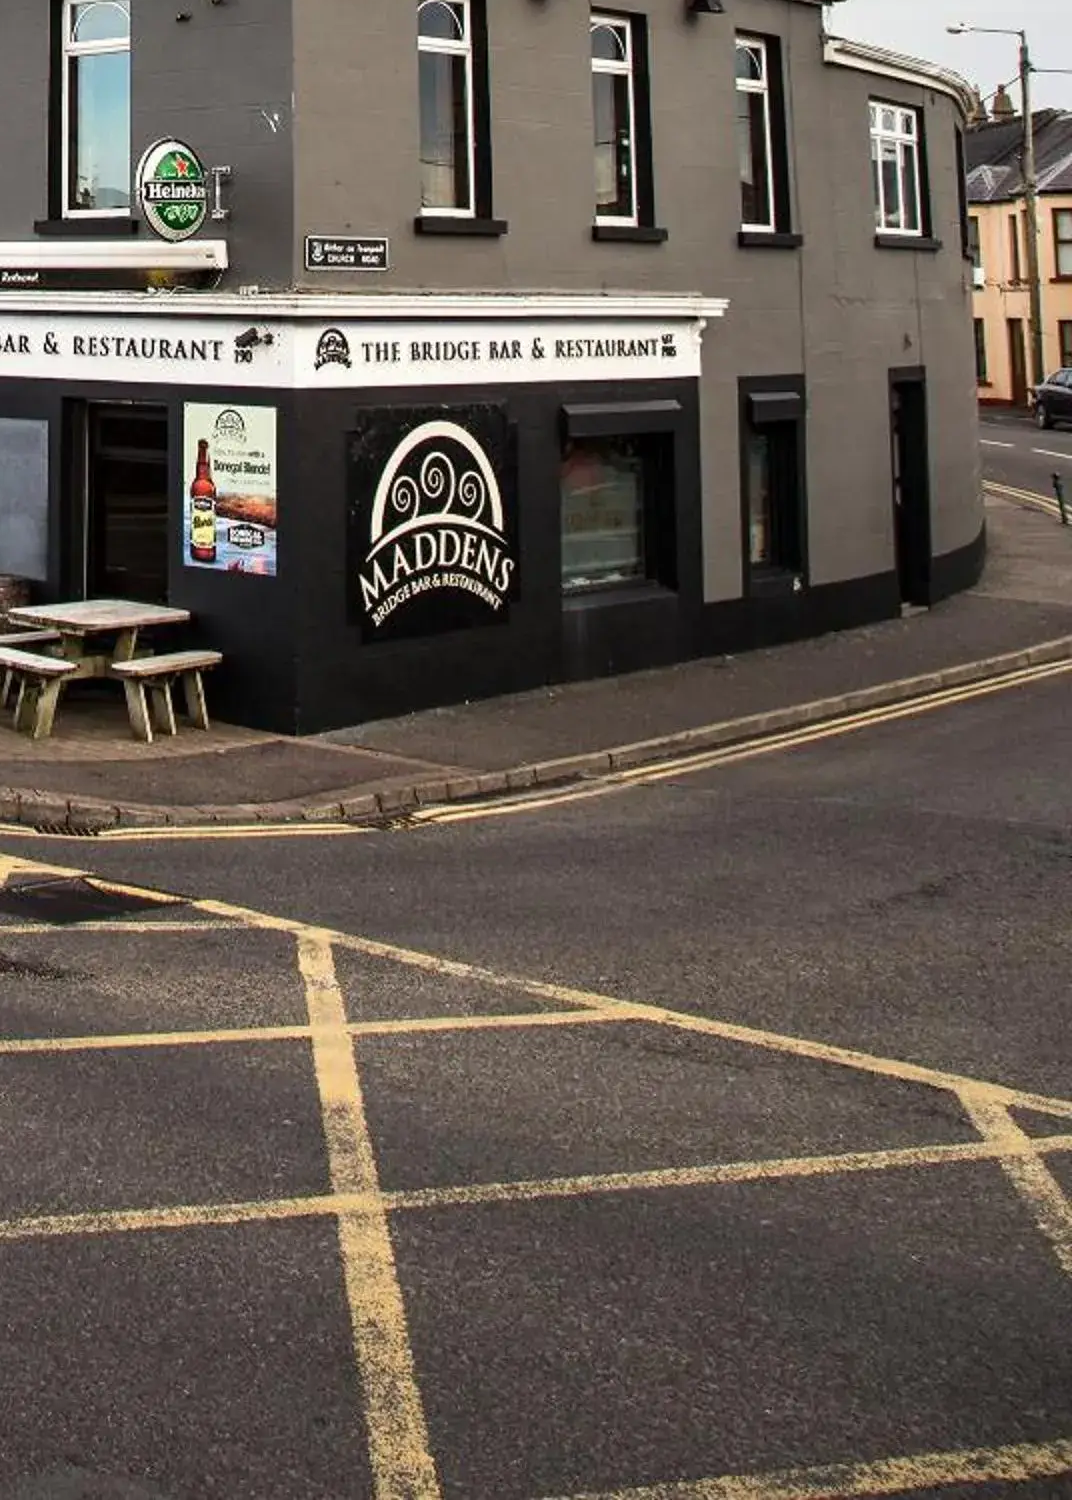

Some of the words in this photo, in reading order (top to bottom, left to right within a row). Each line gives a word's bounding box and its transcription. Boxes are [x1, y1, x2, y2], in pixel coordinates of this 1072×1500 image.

[43, 331, 60, 355] &
[73, 334, 224, 361] RESTAURANT
[361, 341, 401, 362] THE
[409, 340, 481, 361] BRIDGE
[488, 339, 523, 360] BAR
[531, 337, 545, 359] &
[555, 338, 659, 358] RESTAURANT
[358, 529, 515, 612] MADDENS
[371, 583, 411, 627] BRIDGE
[411, 574, 433, 595] BAR
[431, 573, 441, 587] &
[441, 573, 503, 611] RESTAURANT
